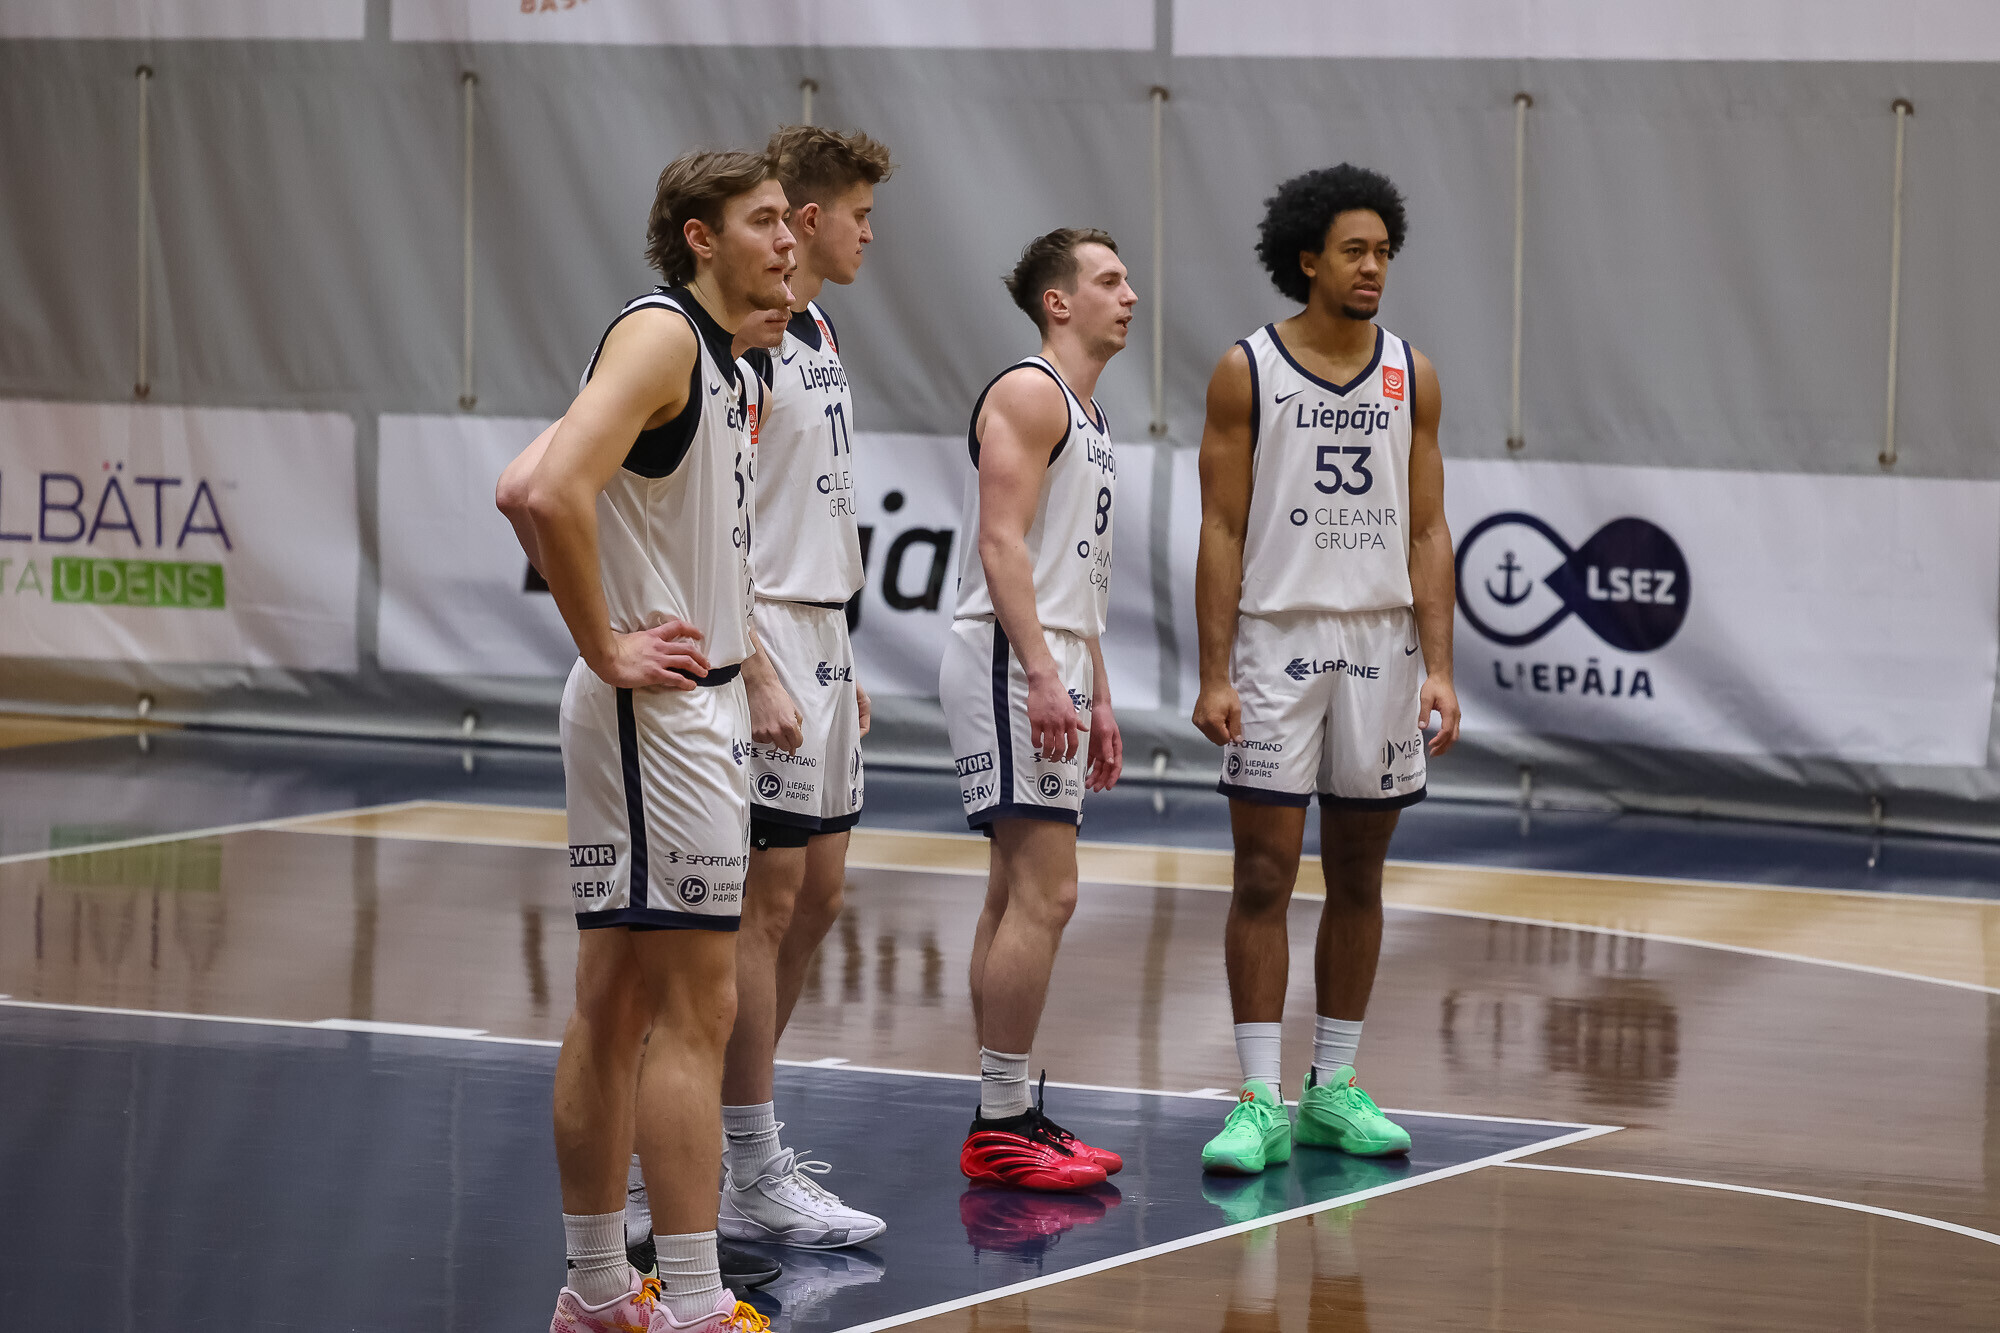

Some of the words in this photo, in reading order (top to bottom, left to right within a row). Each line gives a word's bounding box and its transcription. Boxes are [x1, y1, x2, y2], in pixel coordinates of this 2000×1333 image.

[824, 402, 850, 457] 11
[1296, 401, 1390, 436] Liepāja
[828, 471, 854, 492] CLE
[1314, 445, 1373, 495] 53
[1095, 486, 1112, 536] 8
[1315, 508, 1398, 526] CLEANR
[1315, 532, 1386, 550] GRUPA
[1586, 564, 1677, 605] LSEZ
[1231, 740, 1283, 752] ORTLAND
